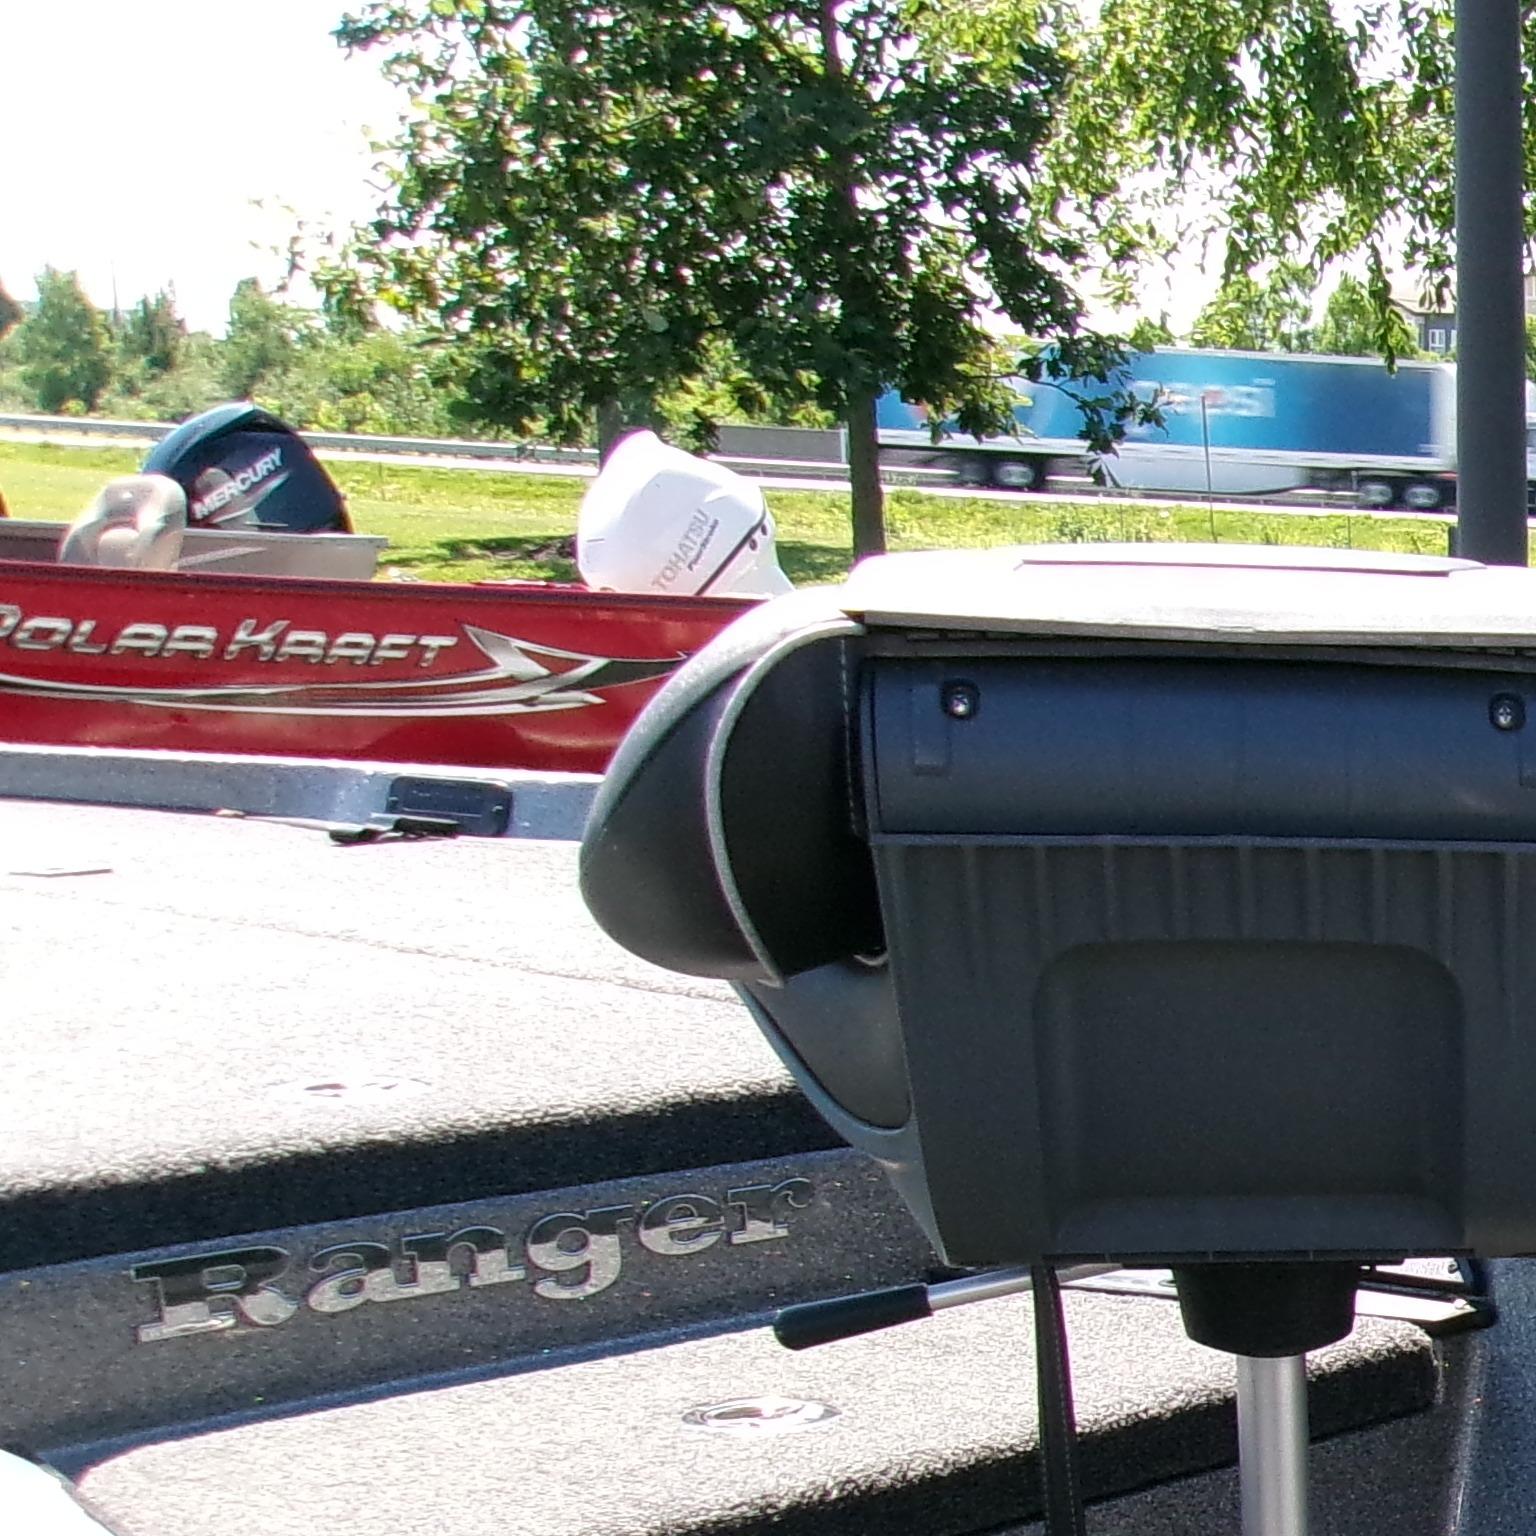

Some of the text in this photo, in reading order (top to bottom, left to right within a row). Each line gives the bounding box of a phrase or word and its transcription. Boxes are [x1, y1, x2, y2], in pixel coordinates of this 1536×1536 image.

[192, 448, 283, 520] MERCURY
[651, 508, 709, 590] TOHATSU
[223, 618, 458, 668] KRAFT
[129, 1178, 813, 1343] Ranger
